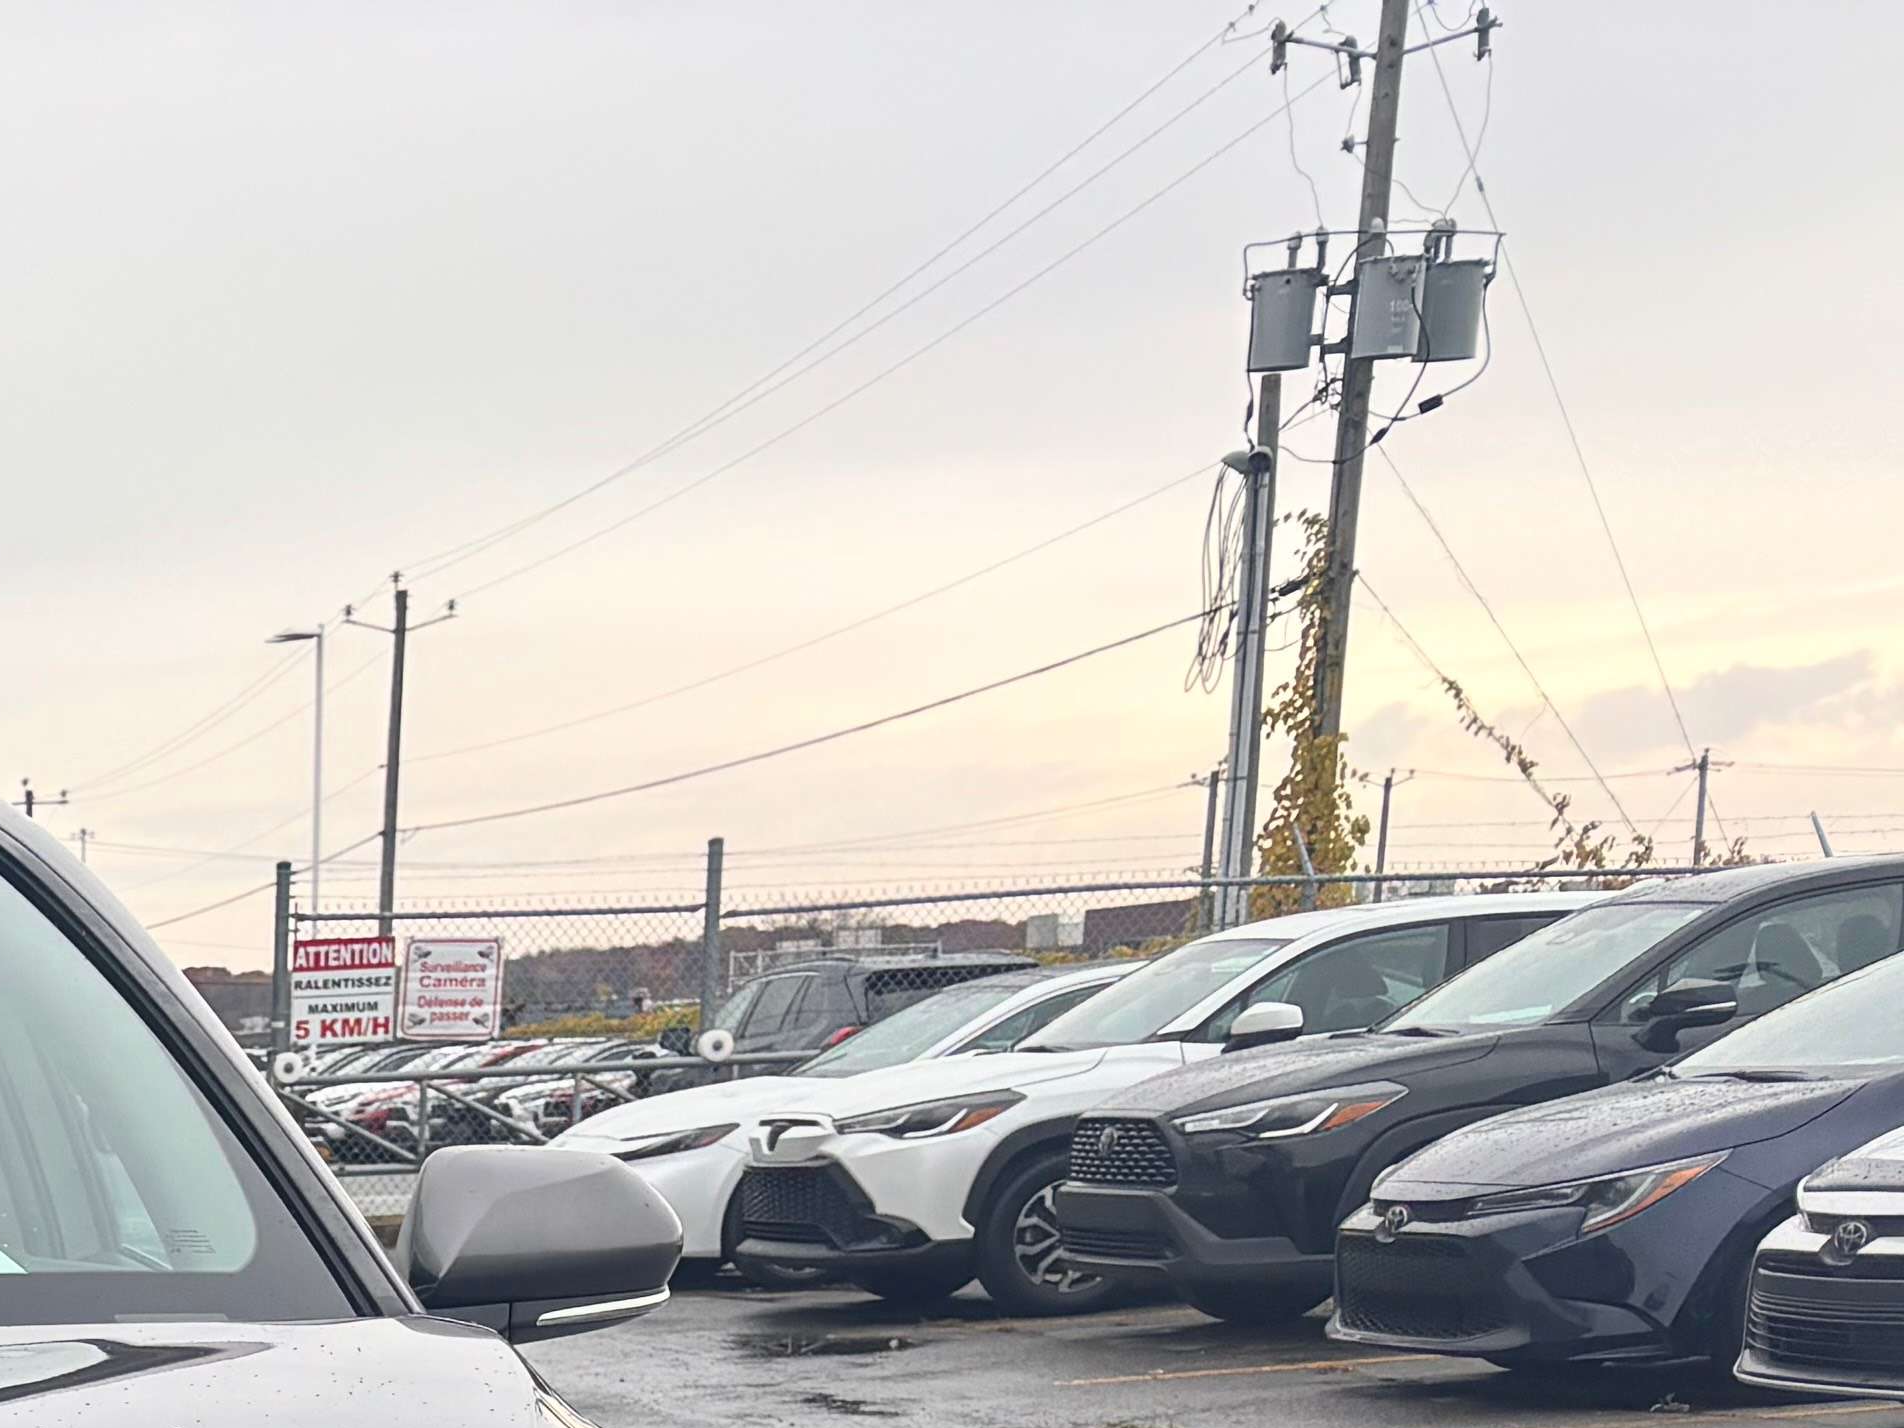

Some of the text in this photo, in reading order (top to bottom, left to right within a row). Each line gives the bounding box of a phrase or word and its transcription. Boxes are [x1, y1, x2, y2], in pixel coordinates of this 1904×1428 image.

[295, 942, 392, 968] ATTENTION
[420, 960, 487, 973] Surveillance
[294, 976, 392, 991] RALENTISSEZ
[419, 974, 486, 989] Caméra
[308, 1001, 378, 1015] MAXIMUM
[470, 996, 484, 1008] de
[430, 1010, 471, 1025] passer
[295, 1016, 390, 1040] 5 KM/H
